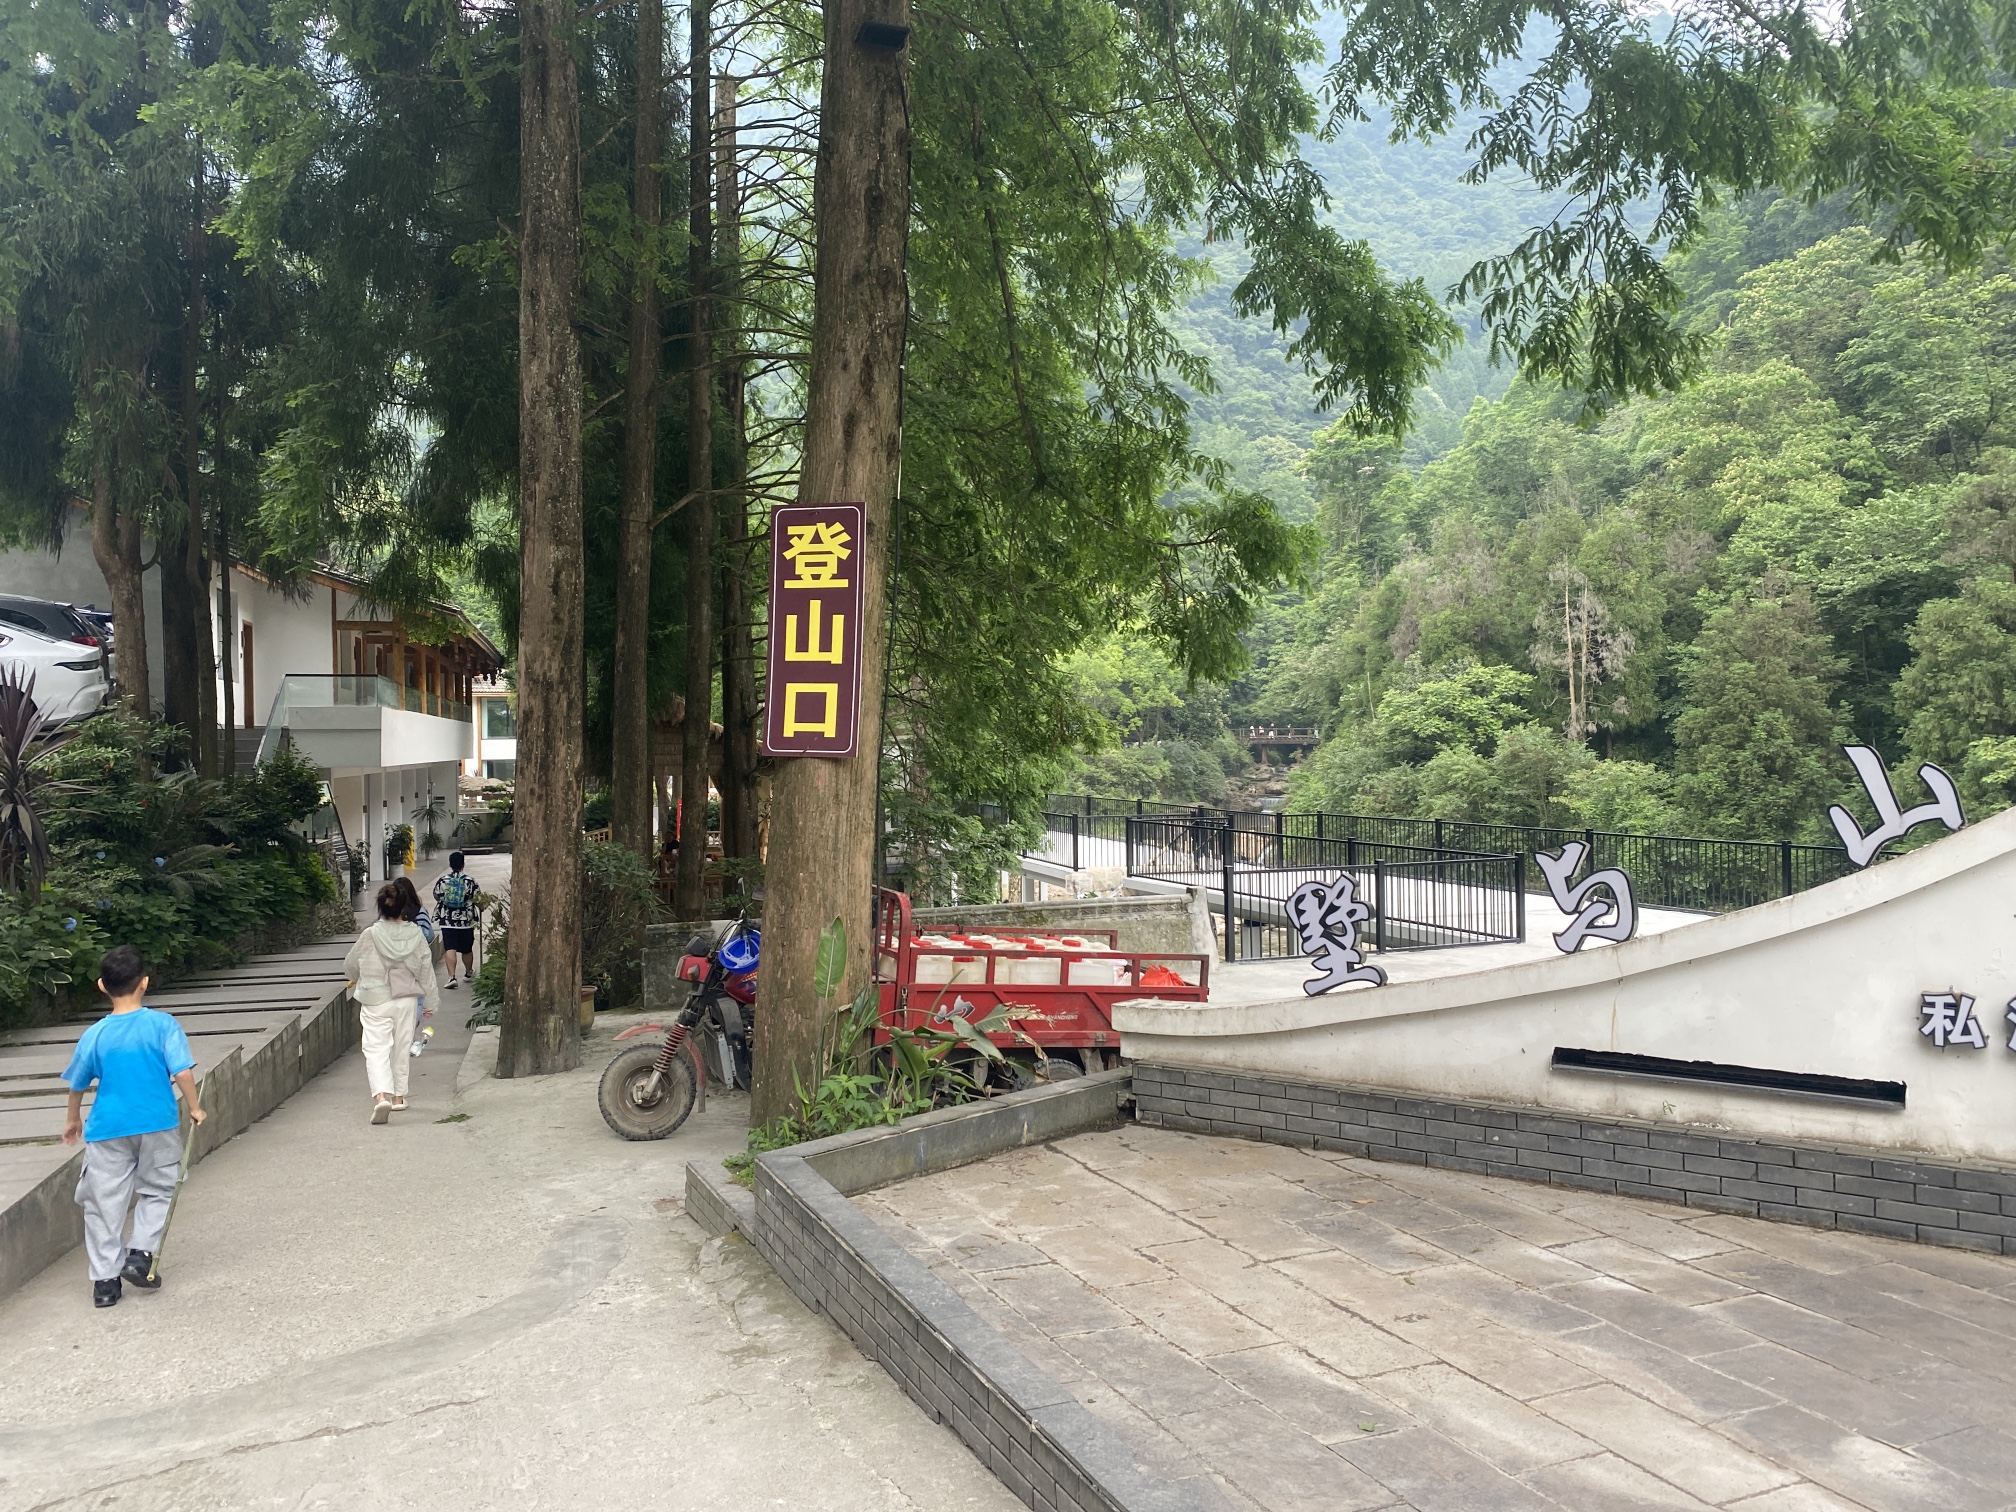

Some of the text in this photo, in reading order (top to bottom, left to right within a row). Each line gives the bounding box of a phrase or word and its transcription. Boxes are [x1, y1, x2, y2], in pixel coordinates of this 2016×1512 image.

[782, 521, 852, 738] 登山口
[1918, 990, 2016, 1054] 私
